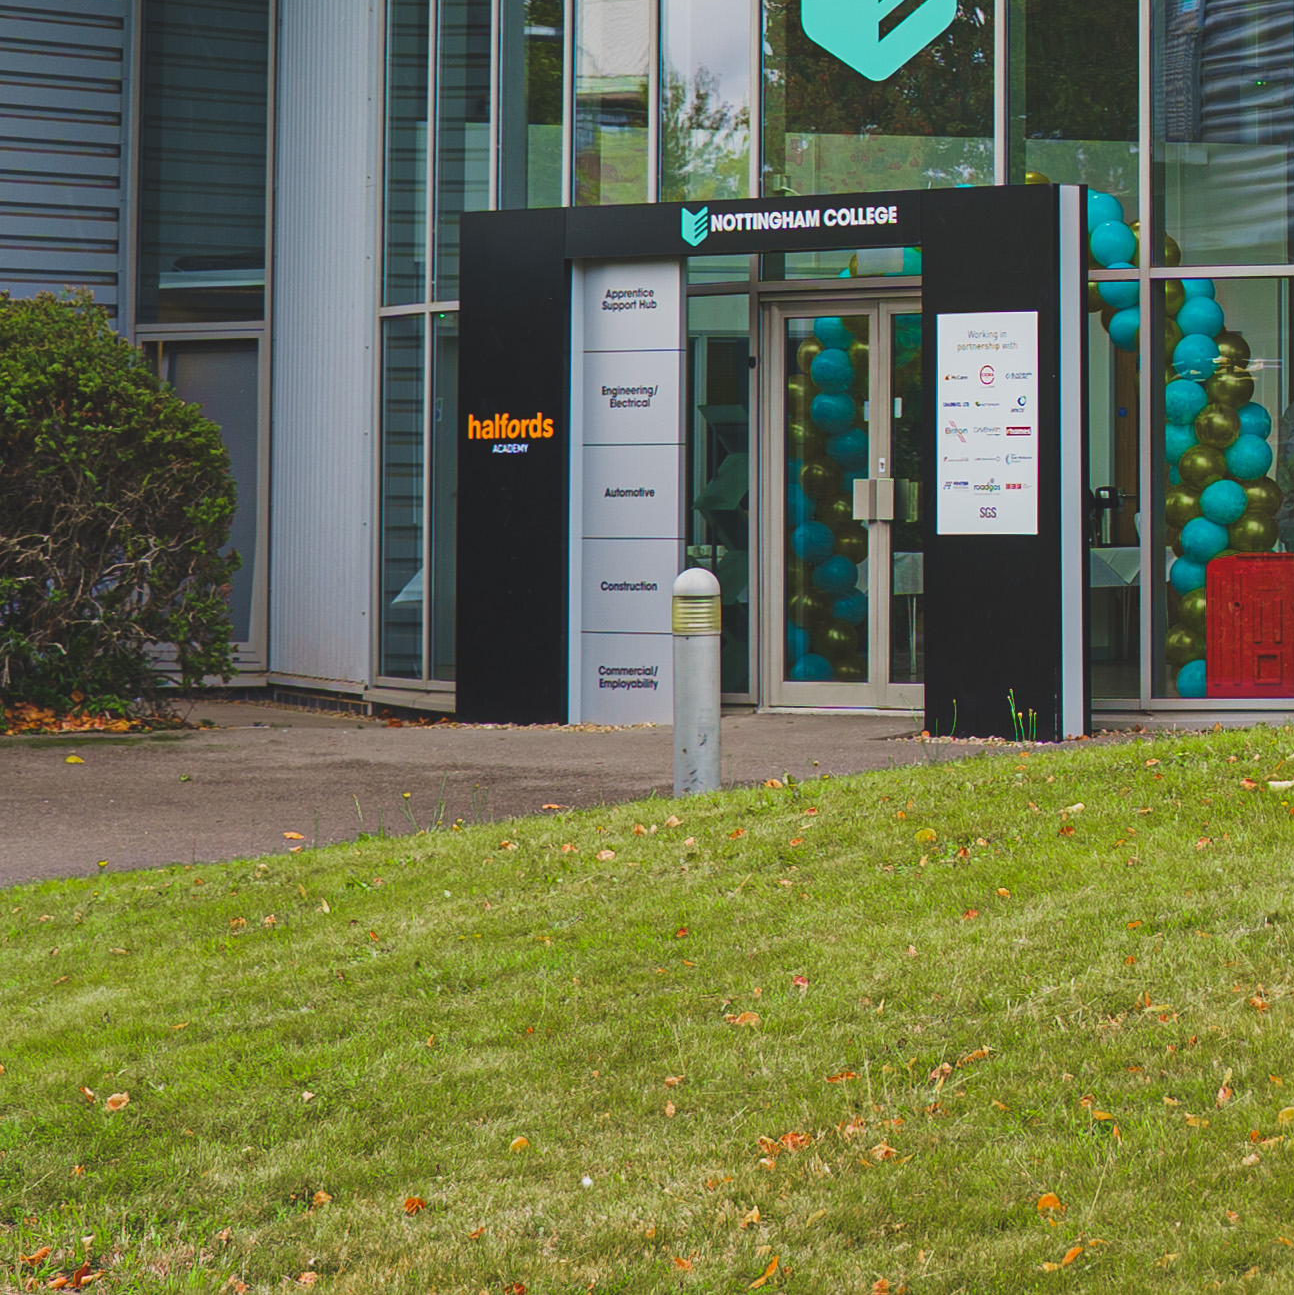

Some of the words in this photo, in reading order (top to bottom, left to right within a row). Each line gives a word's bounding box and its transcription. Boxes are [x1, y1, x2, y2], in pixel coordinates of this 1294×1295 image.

[710, 209, 820, 232] NOTTINGHAM
[823, 206, 898, 227] COLLEGE
[605, 288, 655, 300] Apprentice
[601, 300, 637, 312] Support
[639, 299, 658, 309] Hub
[967, 330, 998, 341] Working
[957, 342, 1000, 353] partnership
[1002, 341, 1018, 350] with
[601, 385, 659, 398] Engineering/
[609, 397, 651, 409] Electrical
[468, 411, 555, 440] halfords
[492, 443, 530, 454] ACADEMY
[604, 487, 656, 499] Automotive
[979, 506, 998, 519] SGS
[600, 581, 658, 592] Construction
[598, 665, 659, 678] Commercial/
[598, 678, 659, 691] Employability
